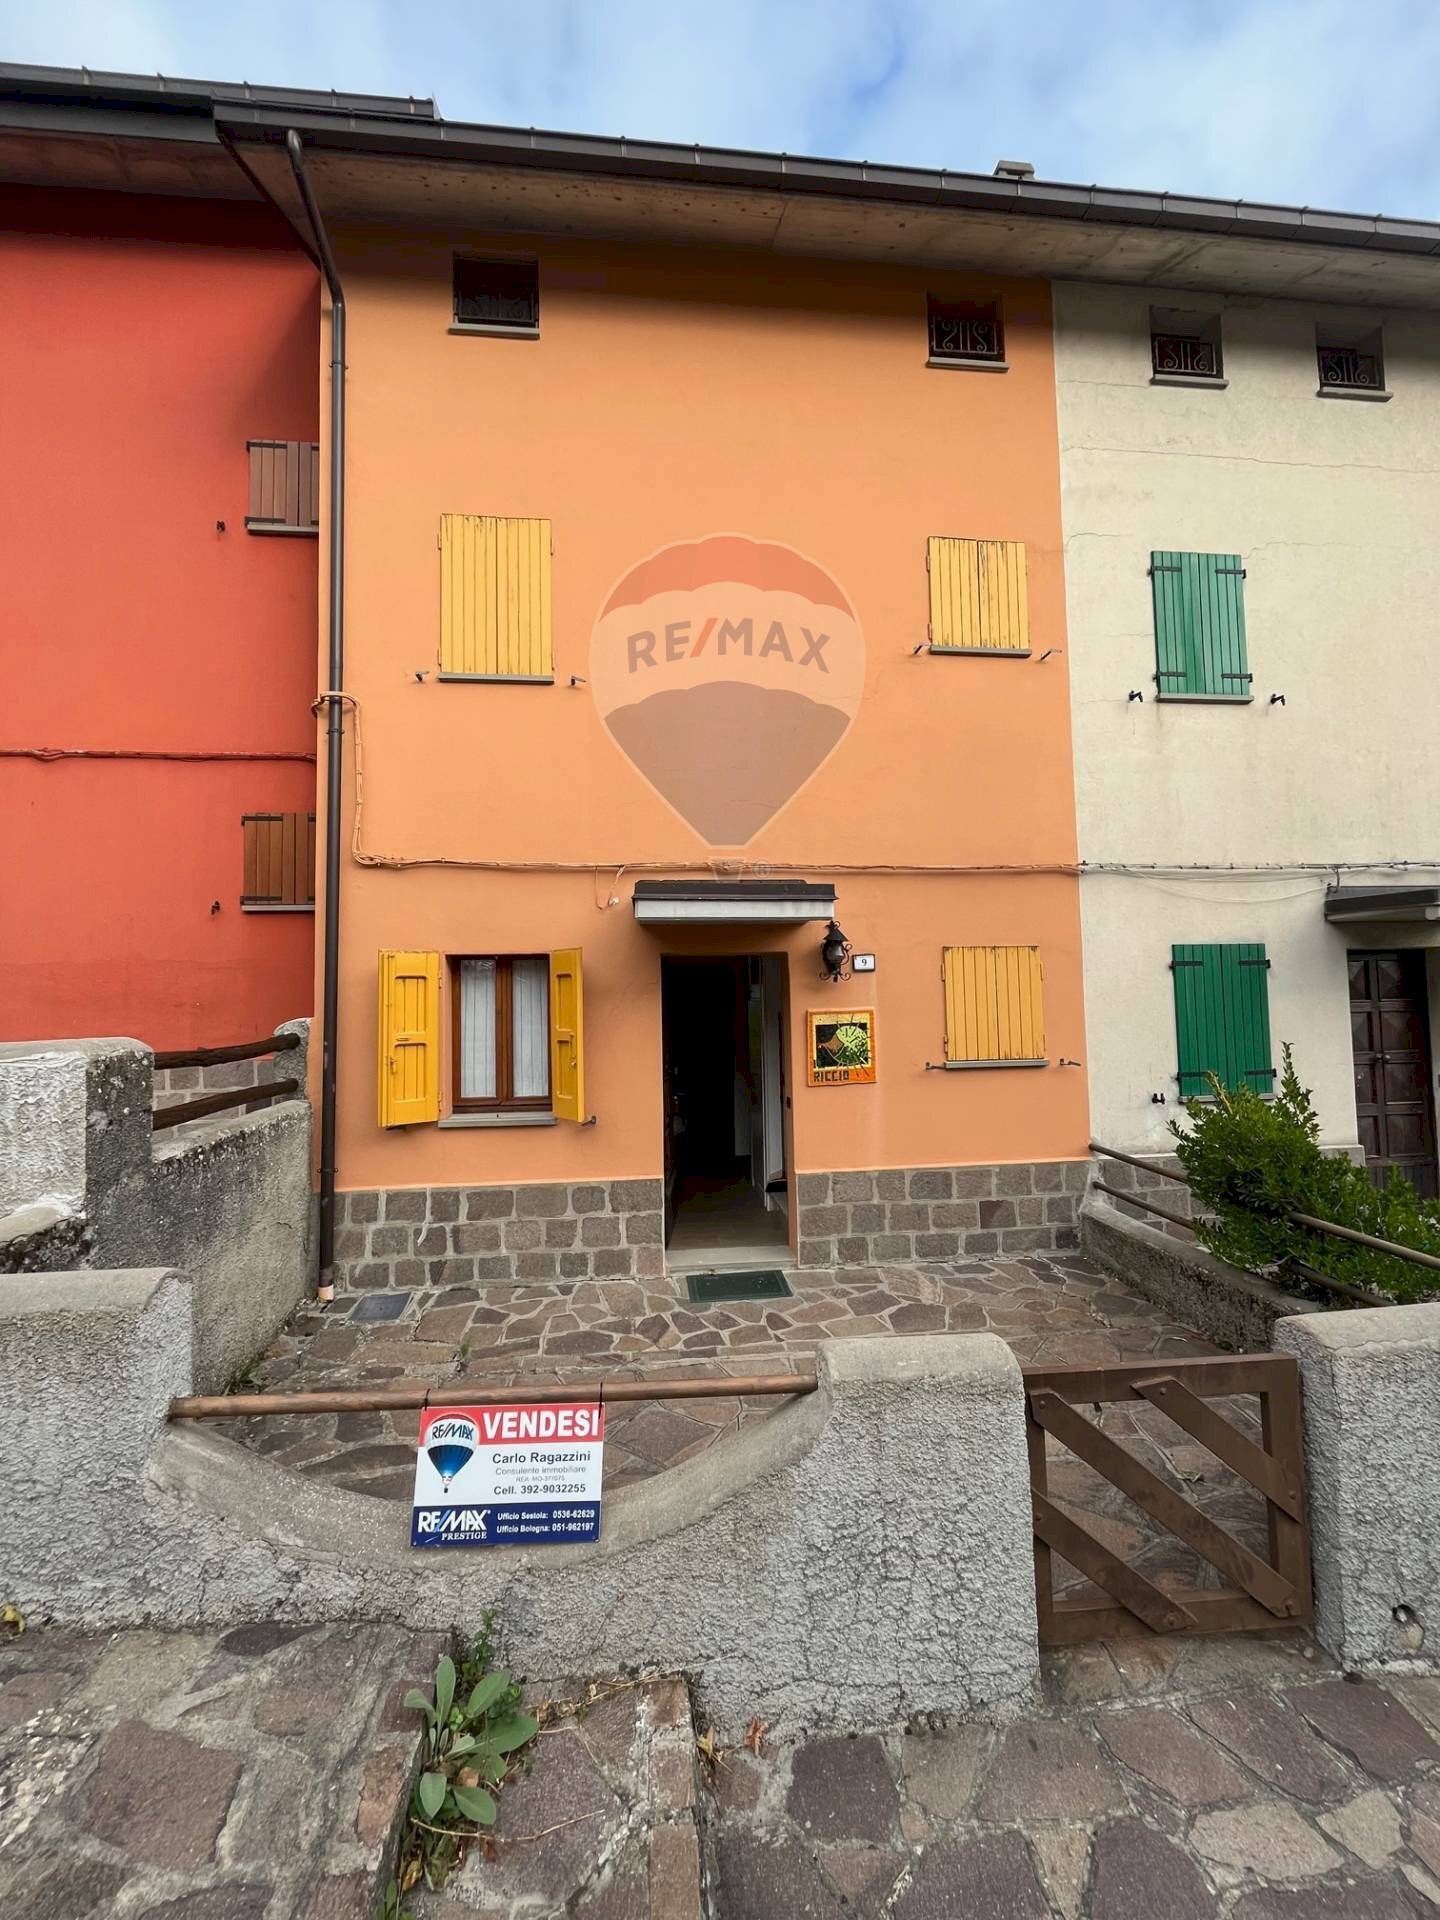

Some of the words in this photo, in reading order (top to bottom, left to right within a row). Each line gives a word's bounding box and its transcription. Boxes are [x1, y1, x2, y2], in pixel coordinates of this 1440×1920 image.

[861, 958, 868, 967] 9
[813, 1070, 850, 1083] RICCIO
[482, 1408, 598, 1440] VENDESI
[431, 1422, 475, 1441] RE/MAX
[492, 1453, 526, 1464] Carlo
[530, 1451, 591, 1465] Ragazzini
[495, 1466, 540, 1476] Consulente
[541, 1465, 586, 1474] immobiliare
[493, 1485, 517, 1495] Cell.
[520, 1483, 586, 1495] 392-9032255
[417, 1509, 488, 1534] RE/MAX
[497, 1512, 520, 1520] Ufficio
[521, 1511, 549, 1520] Sestola:
[496, 1525, 519, 1534] Ufficio
[520, 1524, 550, 1534] Bologna:
[441, 1531, 487, 1541] PRESTIGE
